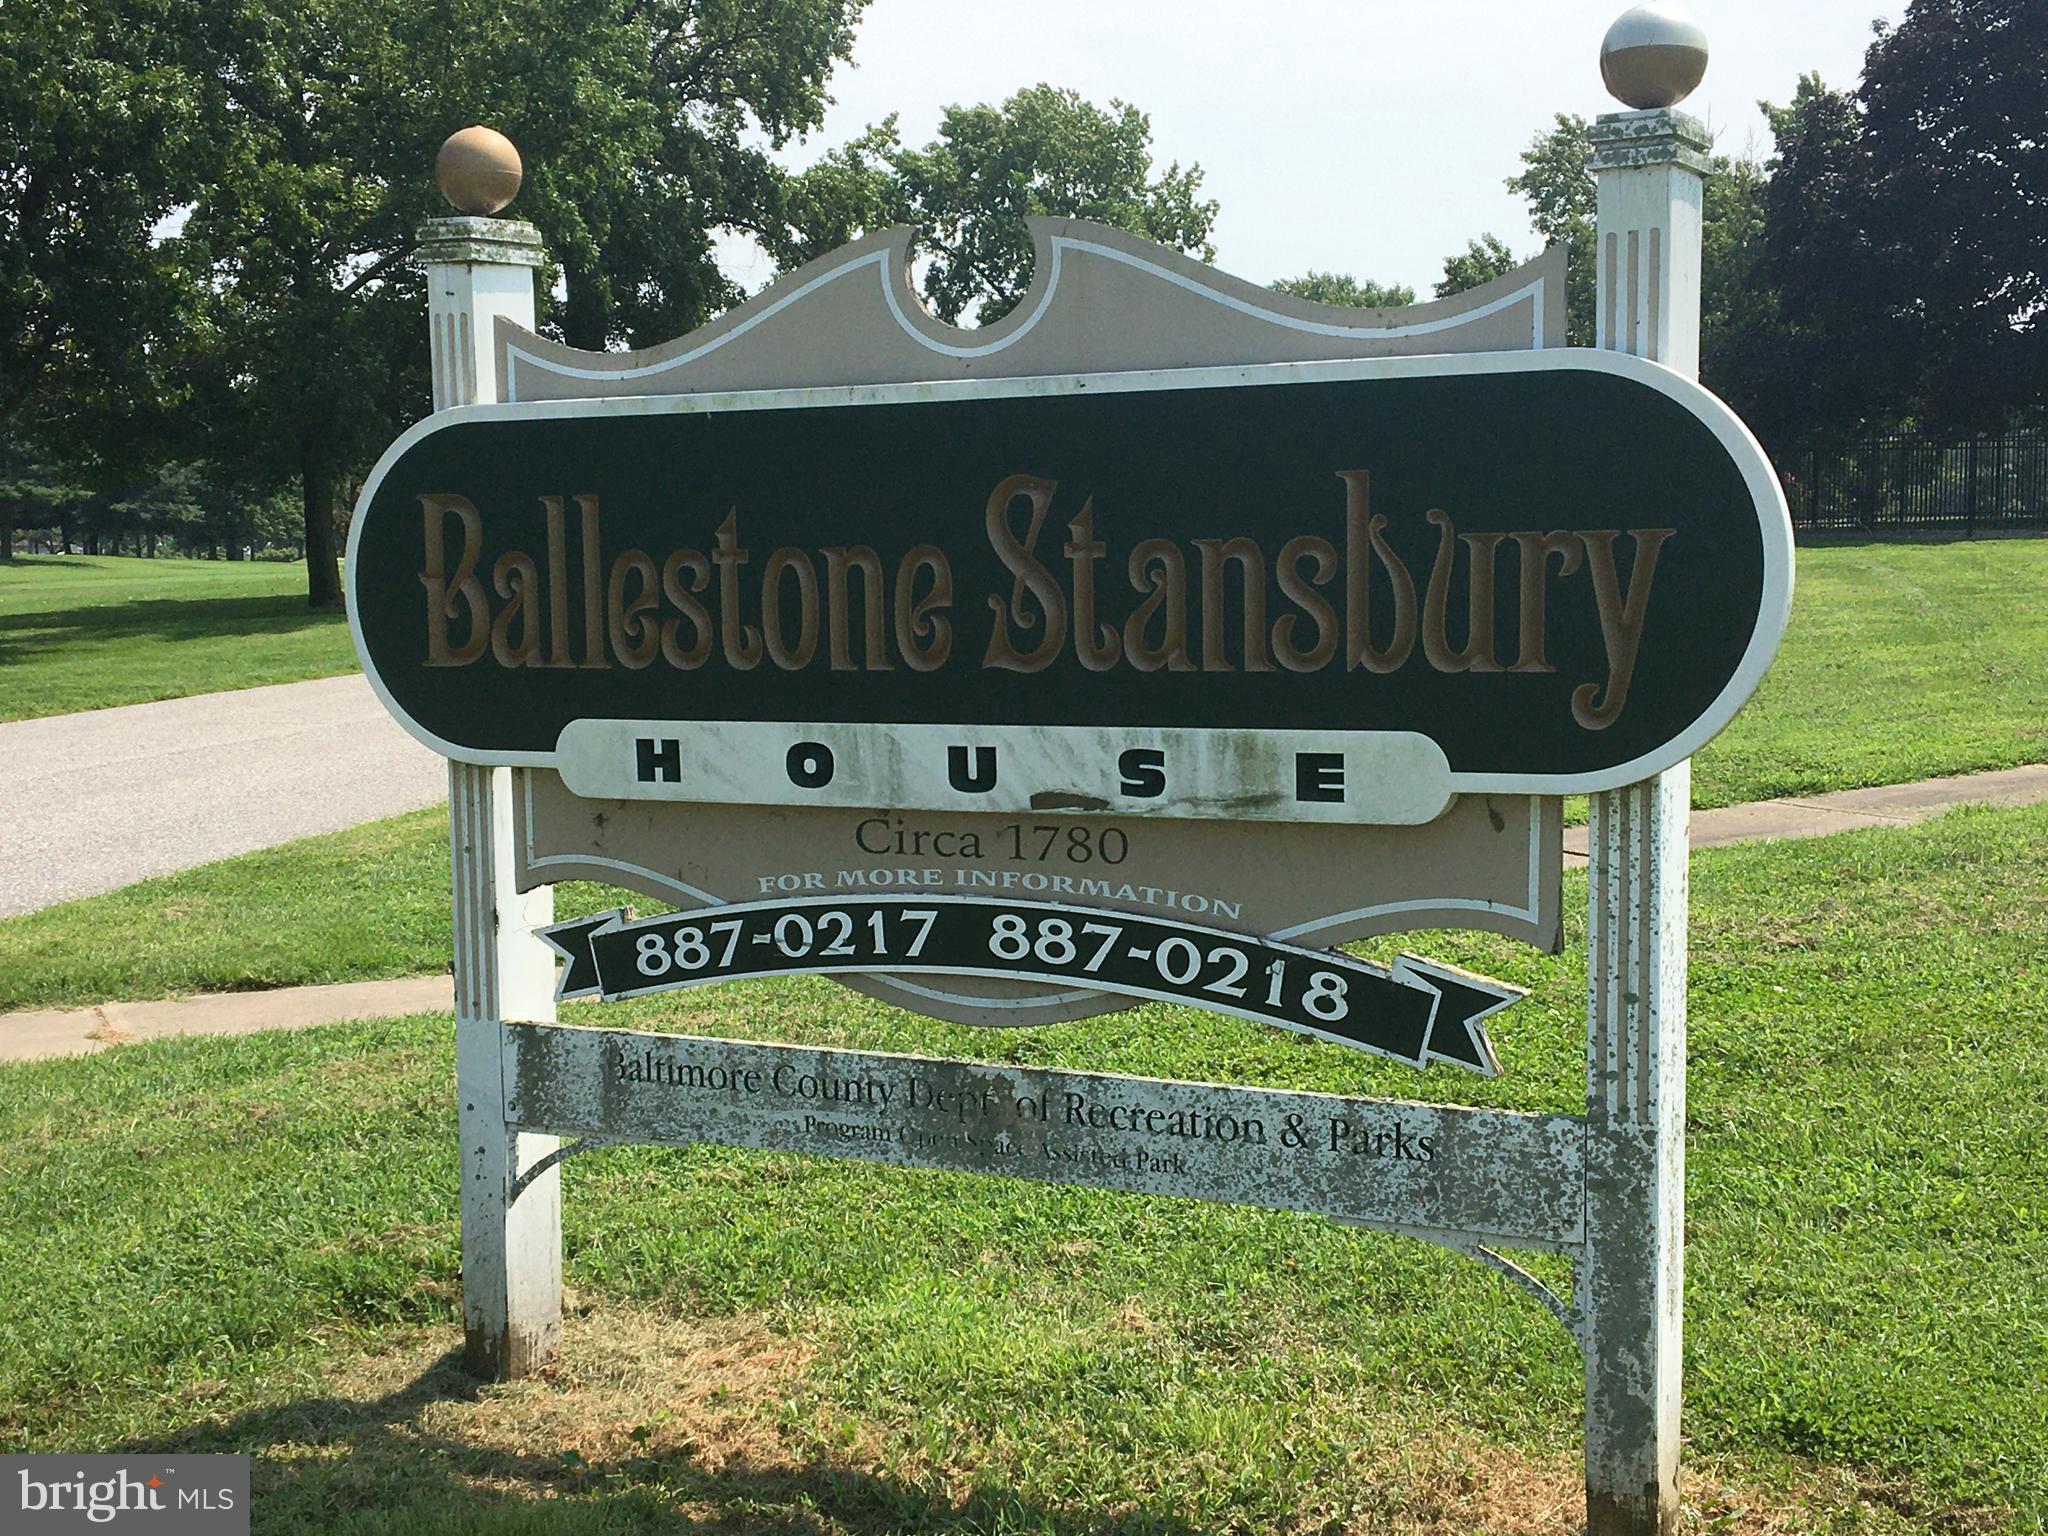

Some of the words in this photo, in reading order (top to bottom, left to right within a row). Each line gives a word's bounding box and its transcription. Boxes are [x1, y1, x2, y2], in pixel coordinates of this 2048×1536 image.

[417, 493, 953, 671] Ballestone
[982, 469, 1677, 730] Stansbury
[635, 739, 1344, 803] HOUSE
[856, 818, 984, 859] Circa
[998, 824, 1129, 865] 1780
[758, 872, 824, 893] FOR
[836, 868, 944, 887] MORE
[955, 869, 1243, 920] INFORMATION
[636, 910, 939, 977] 887-0217
[988, 914, 1349, 1021] 887-0218
[773, 1065, 896, 1115] County
[1015, 1086, 1050, 1122] of
[1065, 1092, 1264, 1146] Recreation
[1280, 1113, 1310, 1149] &
[1329, 1117, 1436, 1163] Parks
[804, 1115, 892, 1143] Program
[1137, 1152, 1185, 1175] Park
